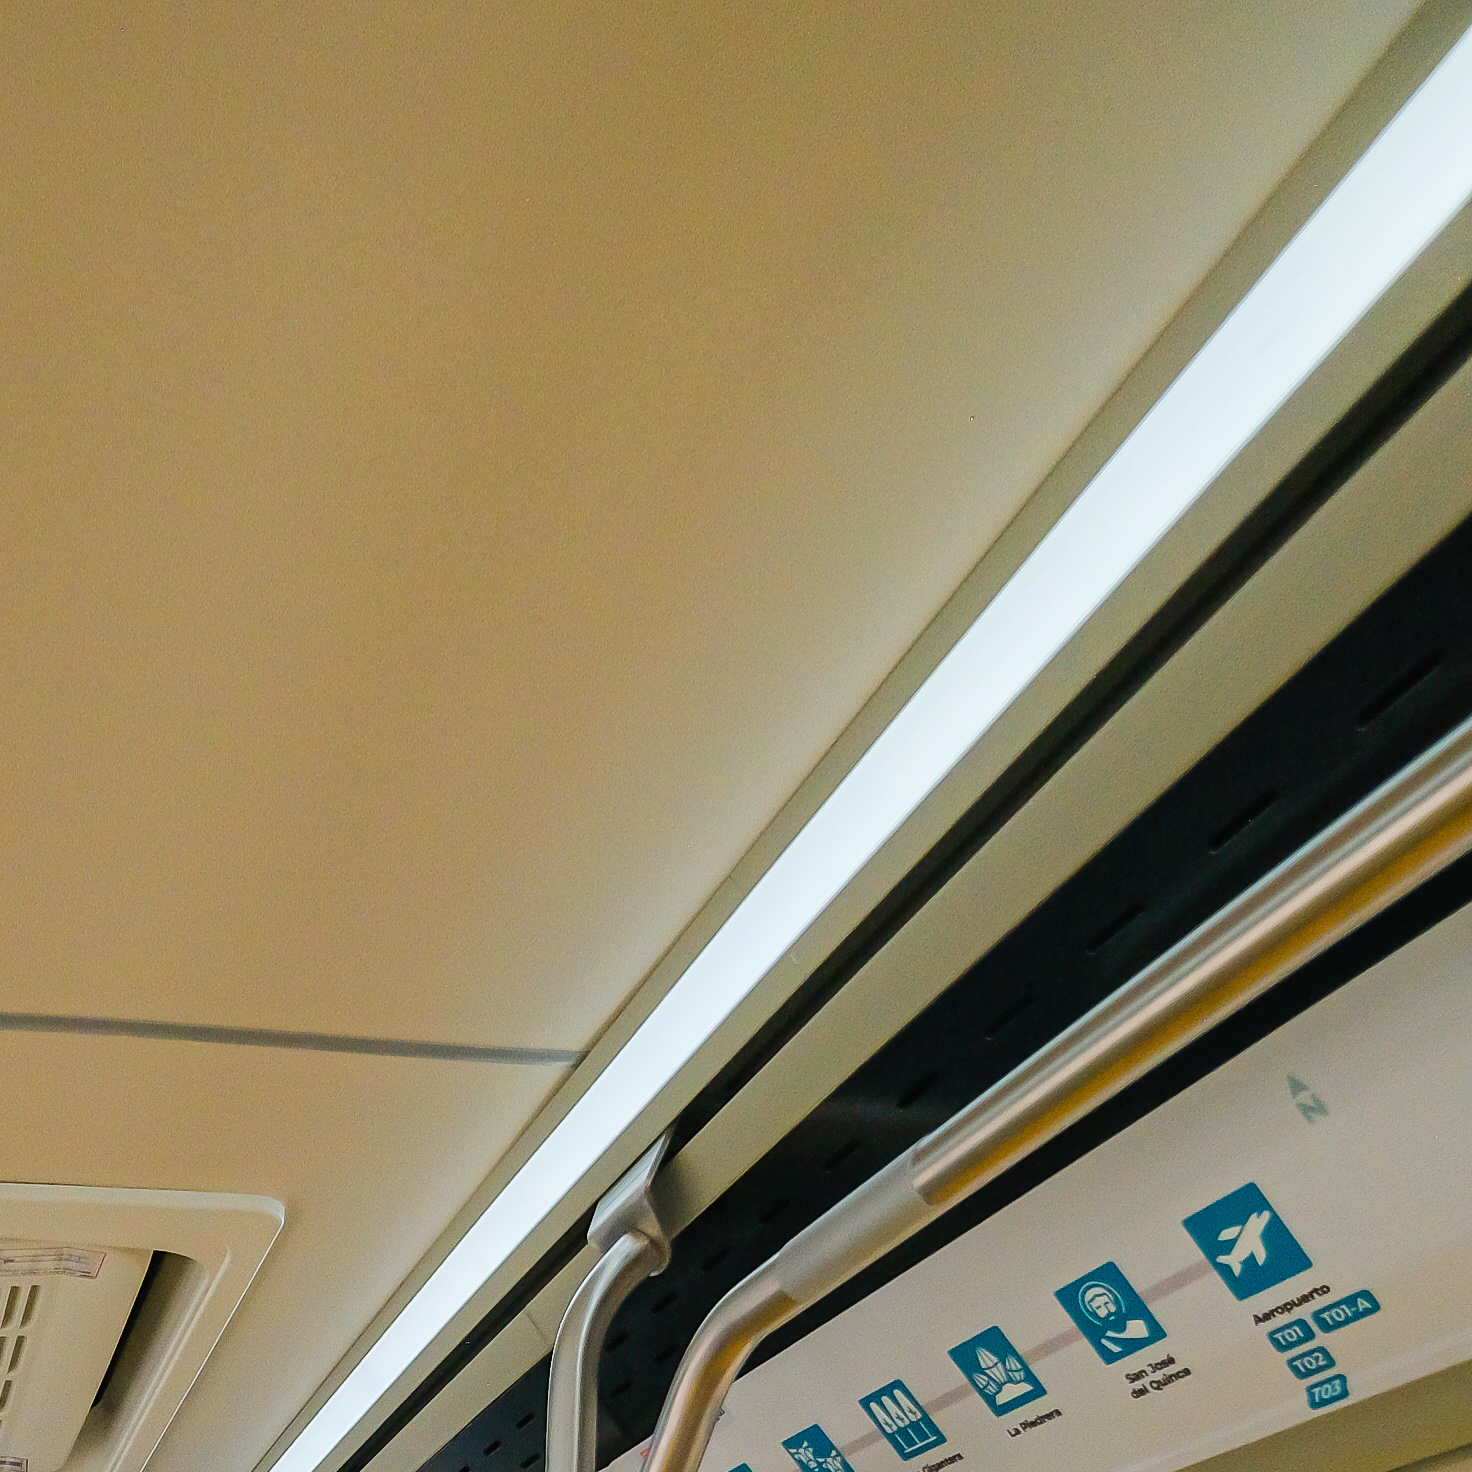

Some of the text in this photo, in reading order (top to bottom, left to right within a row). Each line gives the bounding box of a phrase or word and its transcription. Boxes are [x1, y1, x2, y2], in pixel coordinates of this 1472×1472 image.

[1253, 1284, 1331, 1326] Aeropuerto
[1320, 1297, 1373, 1326] T01-A
[1273, 1325, 1304, 1346] T01
[1292, 1352, 1328, 1373] T02
[1311, 1379, 1342, 1402] T03
